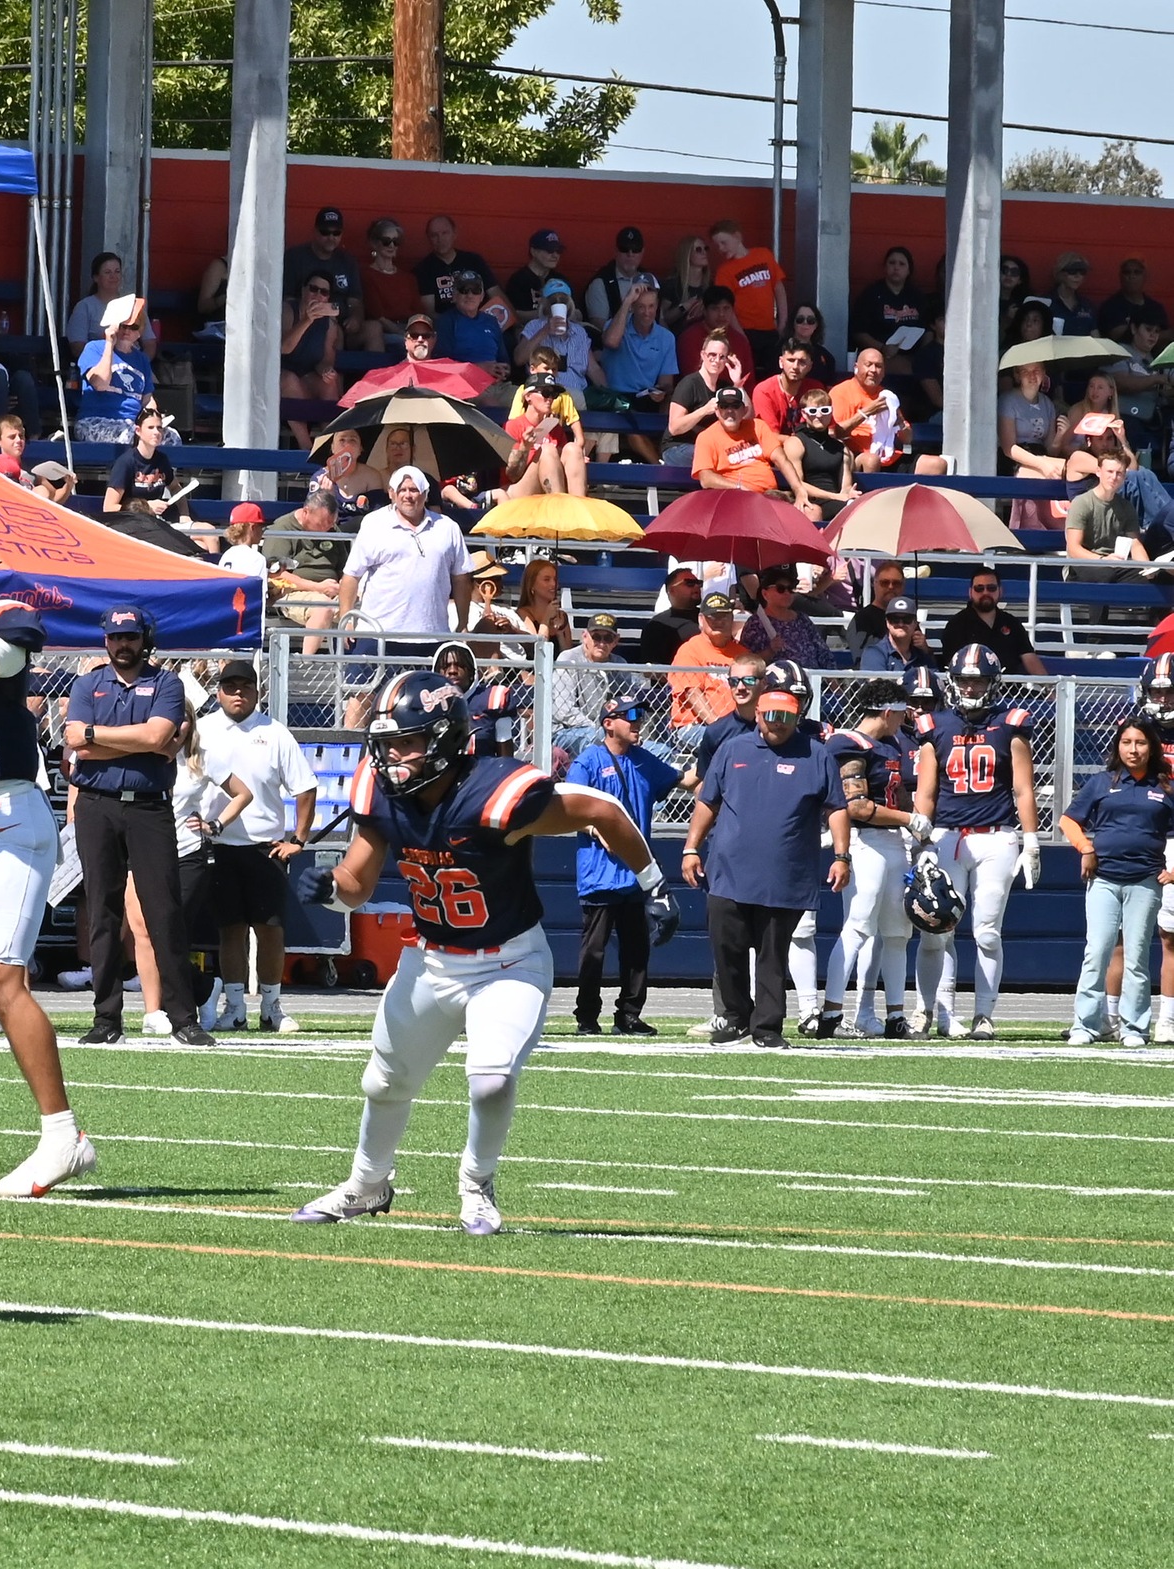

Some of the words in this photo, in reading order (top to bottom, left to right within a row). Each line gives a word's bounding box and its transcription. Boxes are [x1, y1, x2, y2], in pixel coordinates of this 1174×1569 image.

[738, 269, 772, 289] GIANTS
[727, 444, 763, 465] GIANTS
[945, 744, 996, 795] 40
[401, 846, 456, 866] SEQUOIAS
[396, 859, 490, 929] 26
